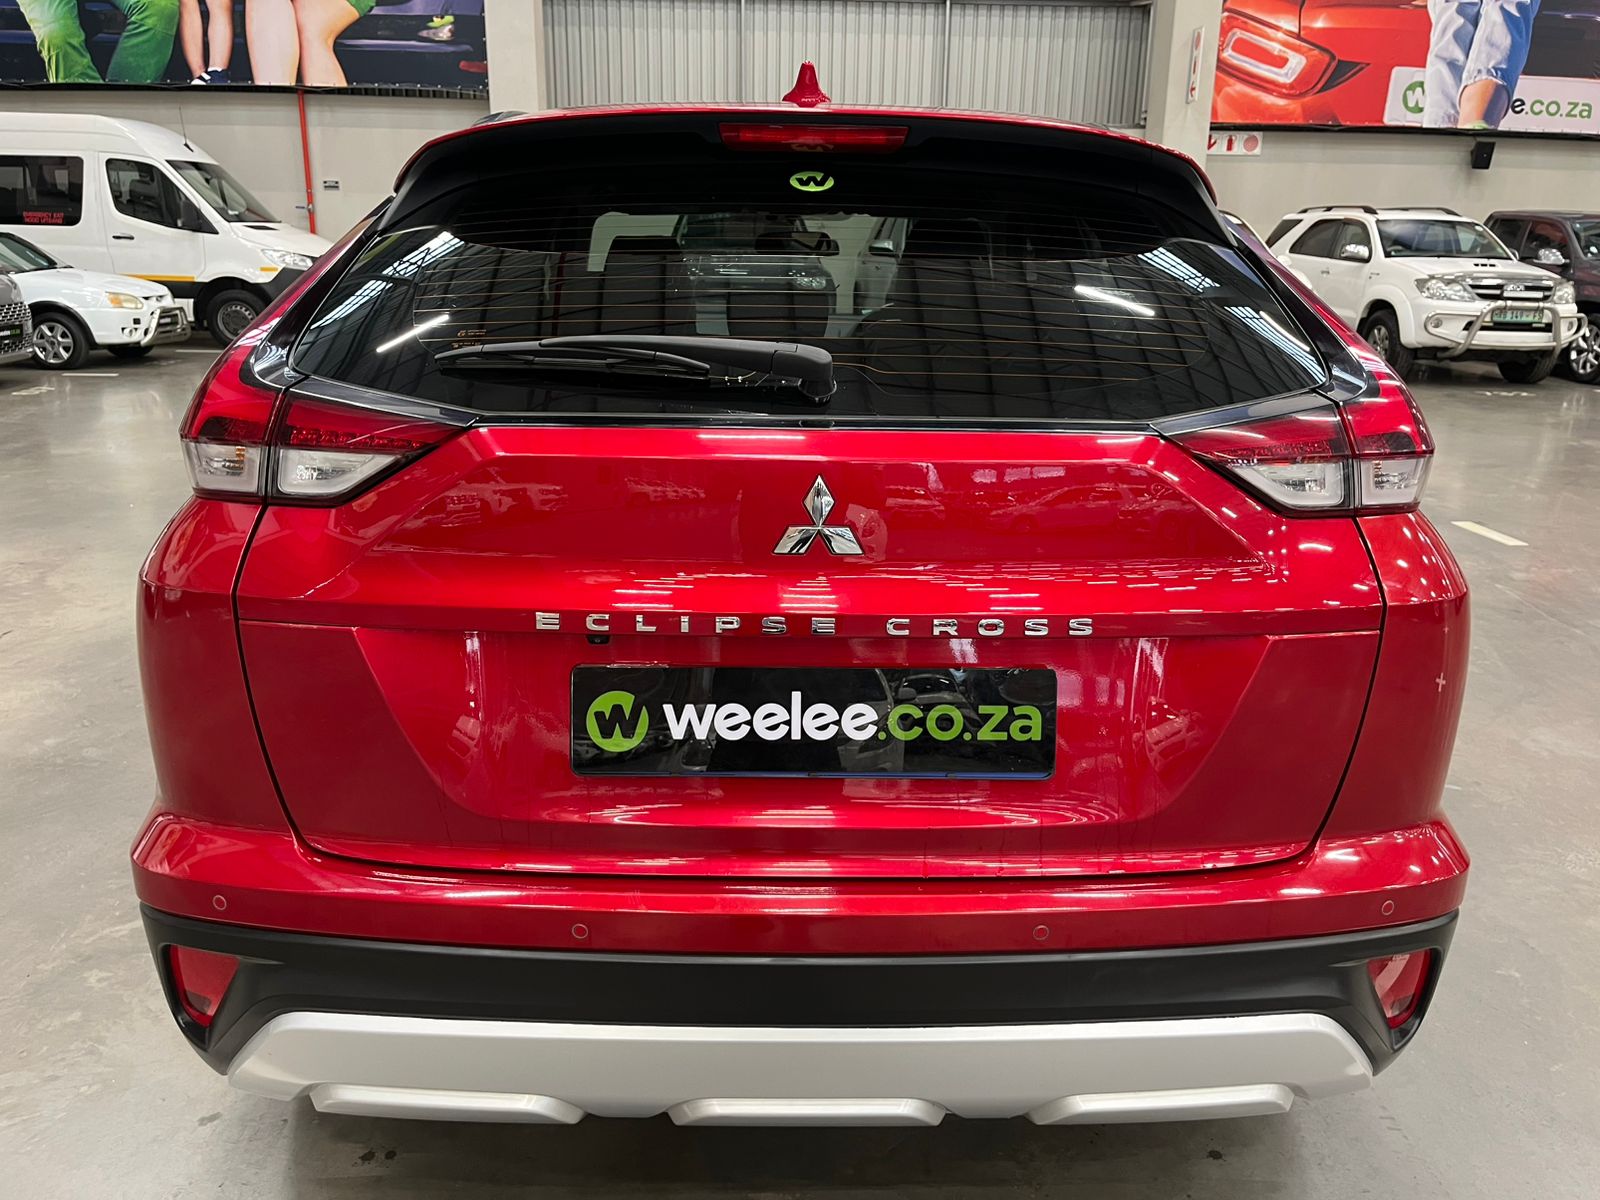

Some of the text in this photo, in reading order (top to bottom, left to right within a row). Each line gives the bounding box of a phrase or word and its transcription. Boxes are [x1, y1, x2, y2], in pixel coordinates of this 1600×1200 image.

[1510, 97, 1593, 119] e.co.za
[535, 611, 1093, 636] ECLIPSE CROSS
[662, 690, 1042, 742] weelee.co.za
